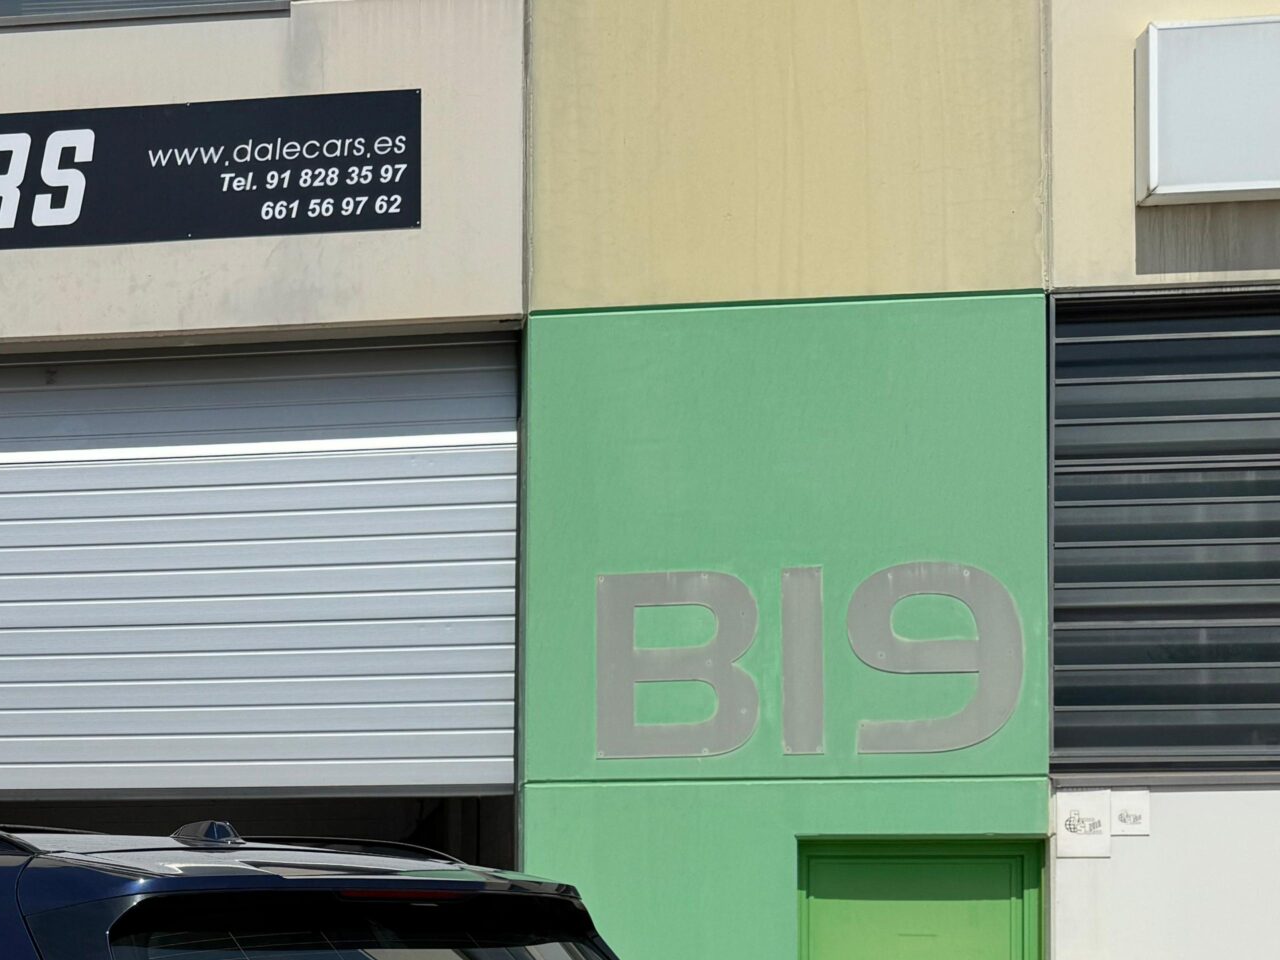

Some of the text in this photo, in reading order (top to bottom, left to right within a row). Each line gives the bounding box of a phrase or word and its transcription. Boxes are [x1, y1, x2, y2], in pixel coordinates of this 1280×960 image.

[148, 135, 407, 167] www.dalecars.es
[220, 163, 408, 192] Tel. 91 828 35 97
[260, 195, 402, 220] 661 56 97 62
[595, 560, 1024, 760] B19
